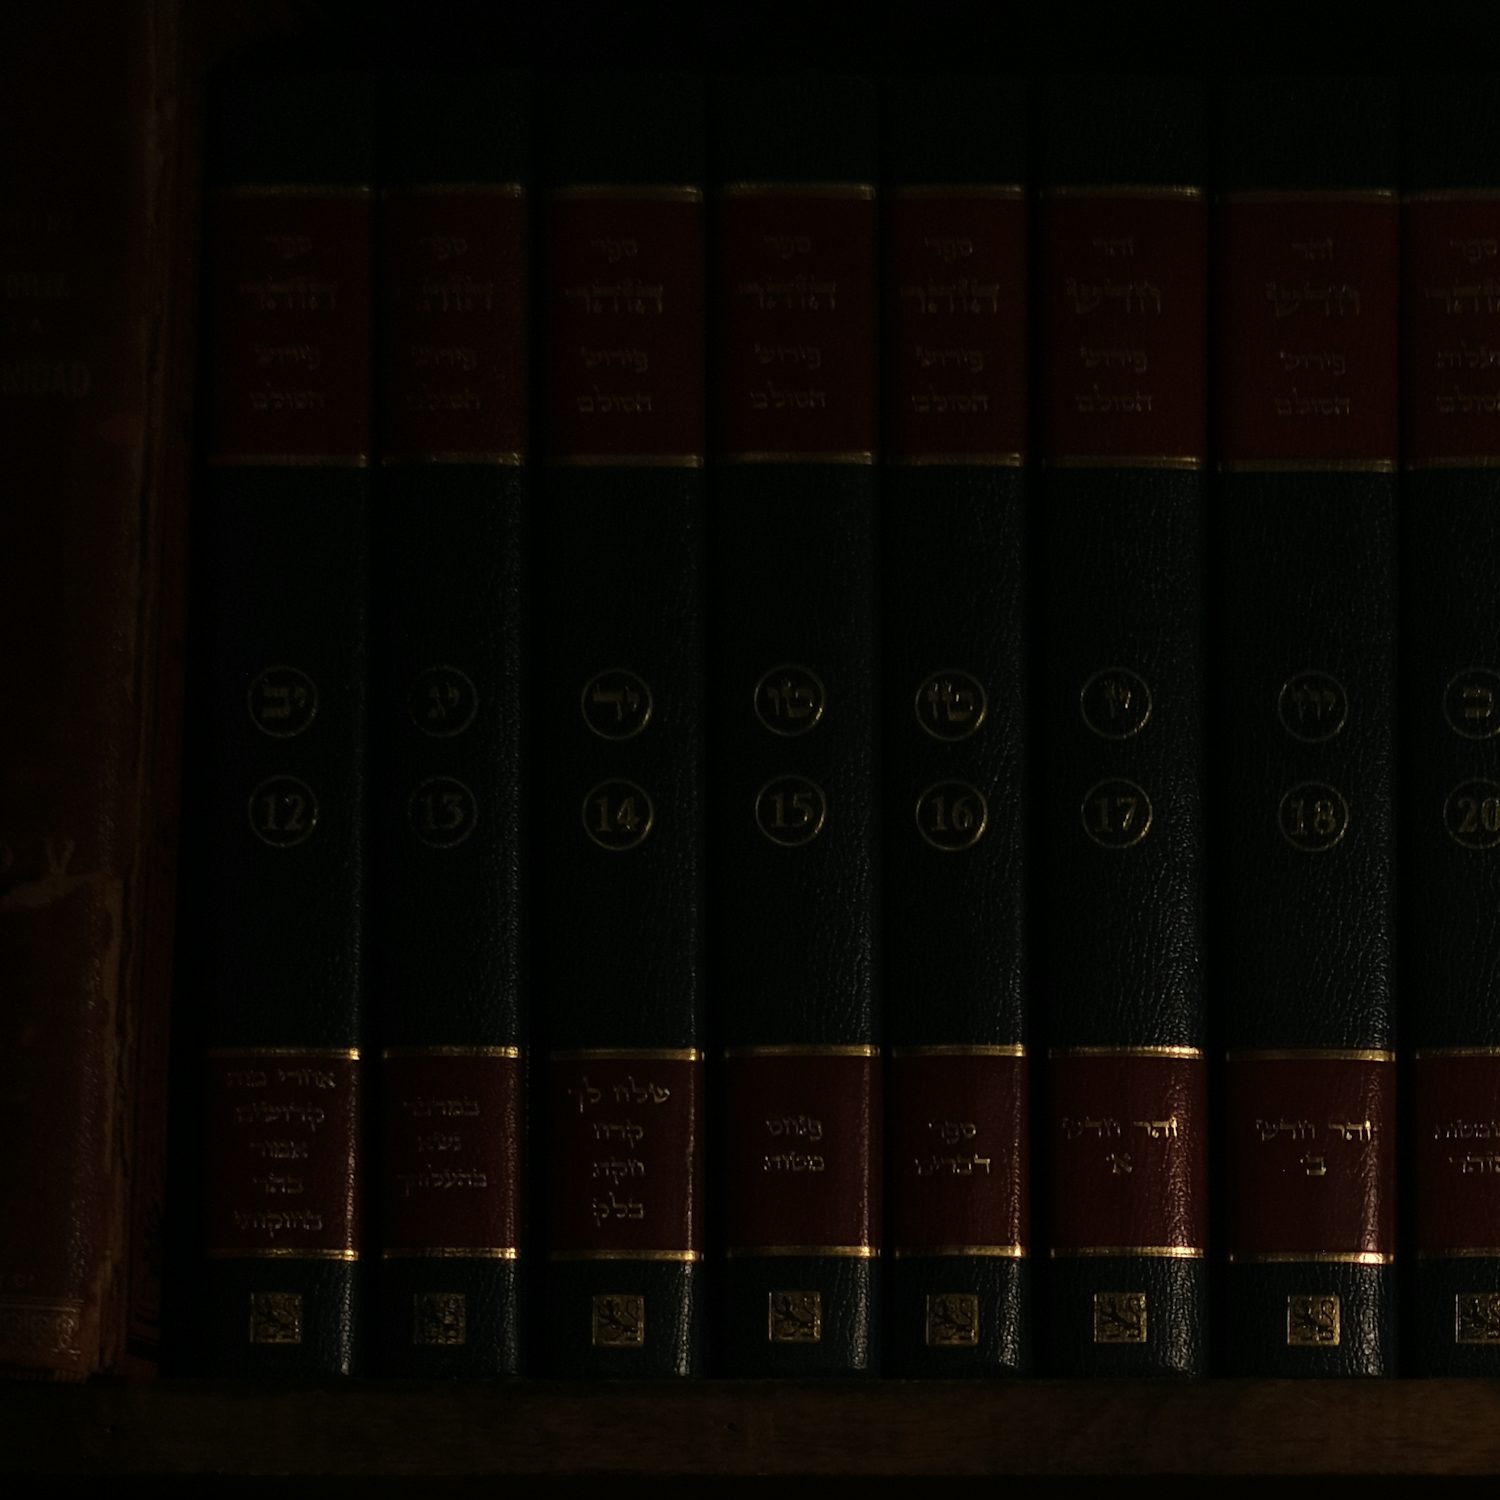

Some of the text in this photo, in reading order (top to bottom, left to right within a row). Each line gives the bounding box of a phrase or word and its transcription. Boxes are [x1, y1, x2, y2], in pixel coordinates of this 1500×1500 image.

[260, 796, 306, 832] 12
[417, 793, 464, 830] 13
[593, 797, 640, 834] 14
[768, 794, 813, 829] 15
[928, 797, 973, 833] 16
[1093, 797, 1135, 832] 17
[1290, 800, 1336, 835] 18
